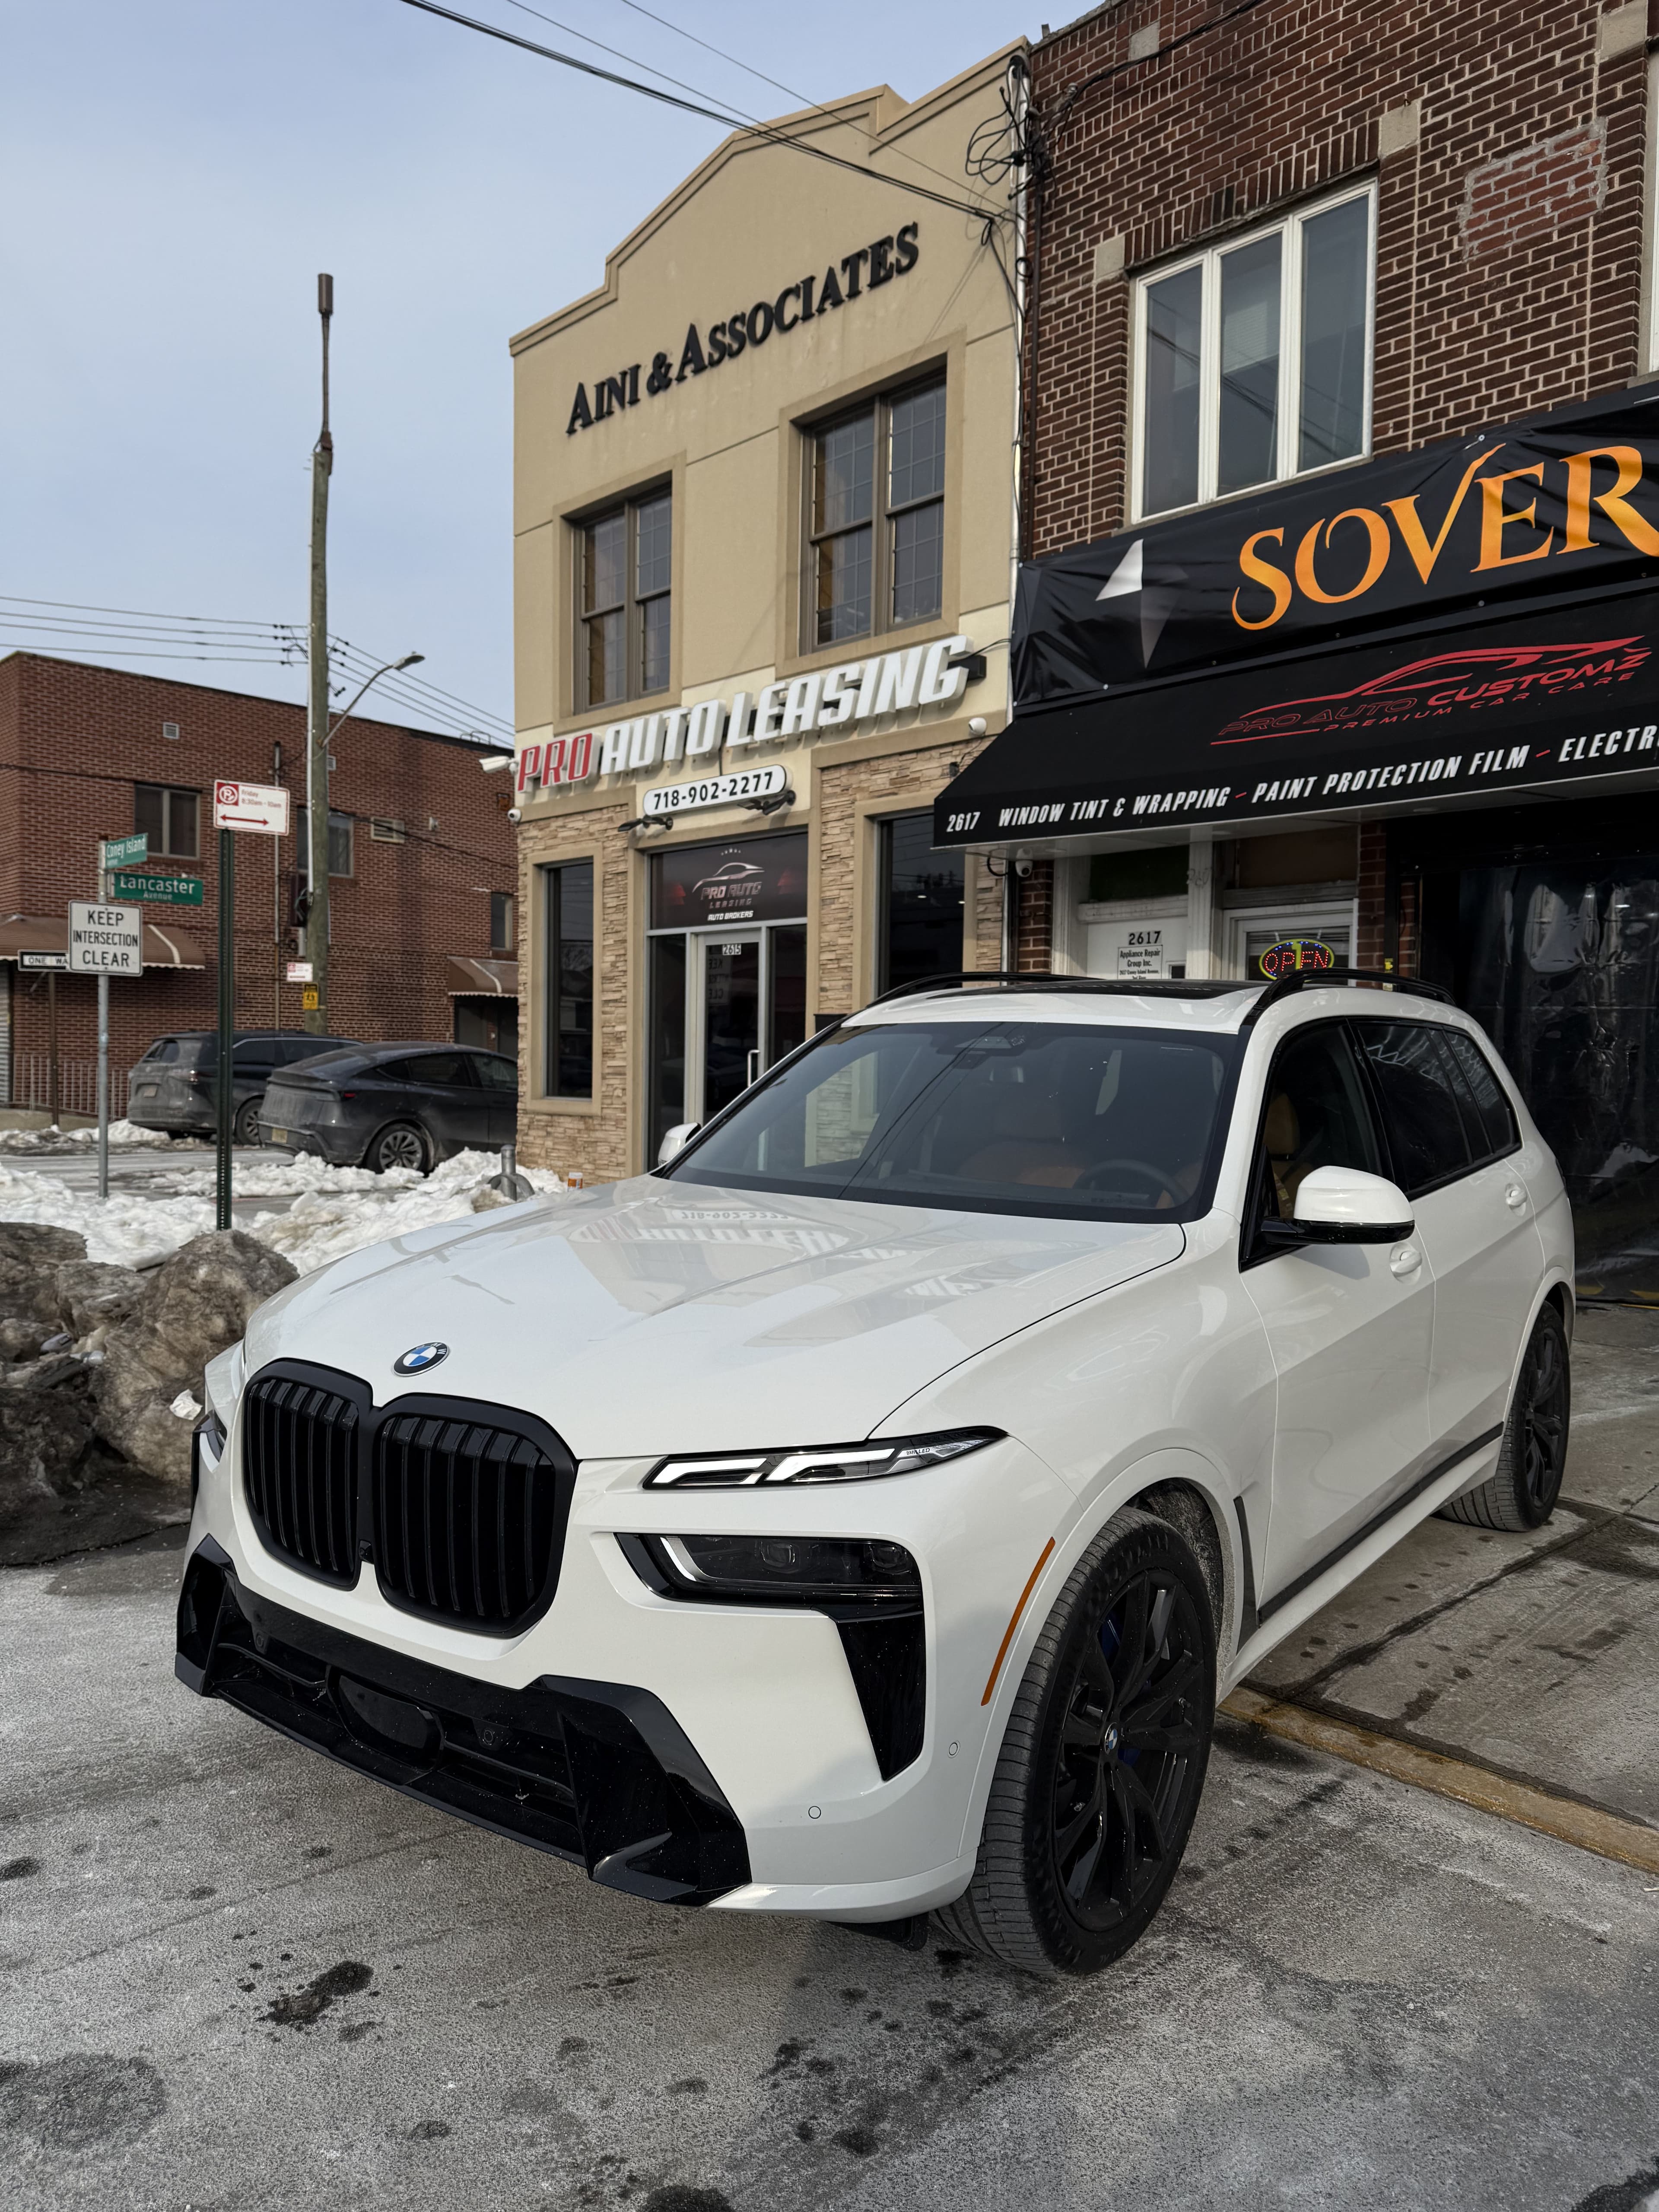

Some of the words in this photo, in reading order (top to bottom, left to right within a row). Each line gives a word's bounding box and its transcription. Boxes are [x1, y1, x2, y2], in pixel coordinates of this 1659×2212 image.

[566, 364, 641, 435] AINI
[646, 352, 673, 395] &
[675, 221, 920, 383] ASSOCIATES
[1232, 443, 1659, 630] SOVER
[1324, 707, 1452, 731] PREMIUM
[1470, 693, 1530, 709] CAR
[1548, 672, 1635, 694] CARE
[518, 732, 598, 792] PRO
[601, 699, 727, 775] AUTO
[727, 635, 973, 748] LEASING
[1218, 714, 1301, 735] PRO
[1303, 698, 1417, 724] AUTO
[946, 812, 981, 833] 2617
[998, 803, 1066, 827] WINDOW
[1070, 799, 1109, 821] TINT
[1112, 798, 1126, 817] &
[1132, 786, 1232, 815] WRAPPING
[1251, 775, 1318, 804] PAINT
[1322, 755, 1463, 795] PROTECTION
[1468, 745, 1531, 775] FILM
[1557, 725, 1659, 763] ELECTR
[654, 771, 773, 810] 718-902-2277
[107, 842, 124, 858] Coney
[126, 835, 146, 854] Island
[120, 875, 195, 895] Lancaster
[700, 886, 727, 900] PRO
[728, 882, 762, 898] AUTO
[143, 891, 173, 900] Avenue
[709, 898, 752, 909] LEASING
[88, 910, 124, 926] KEEP
[724, 910, 753, 920] BROKERS
[73, 930, 138, 947] INTERSECTION
[1128, 930, 1162, 945] 2617
[28, 956, 46, 964] ONE
[55, 956, 69, 964] WA
[83, 950, 130, 967] CLEAR
[1120, 950, 1143, 960] Appliance
[1144, 948, 1160, 958] Repair
[1264, 950, 1329, 973] OPEN
[1127, 959, 1142, 968] Group
